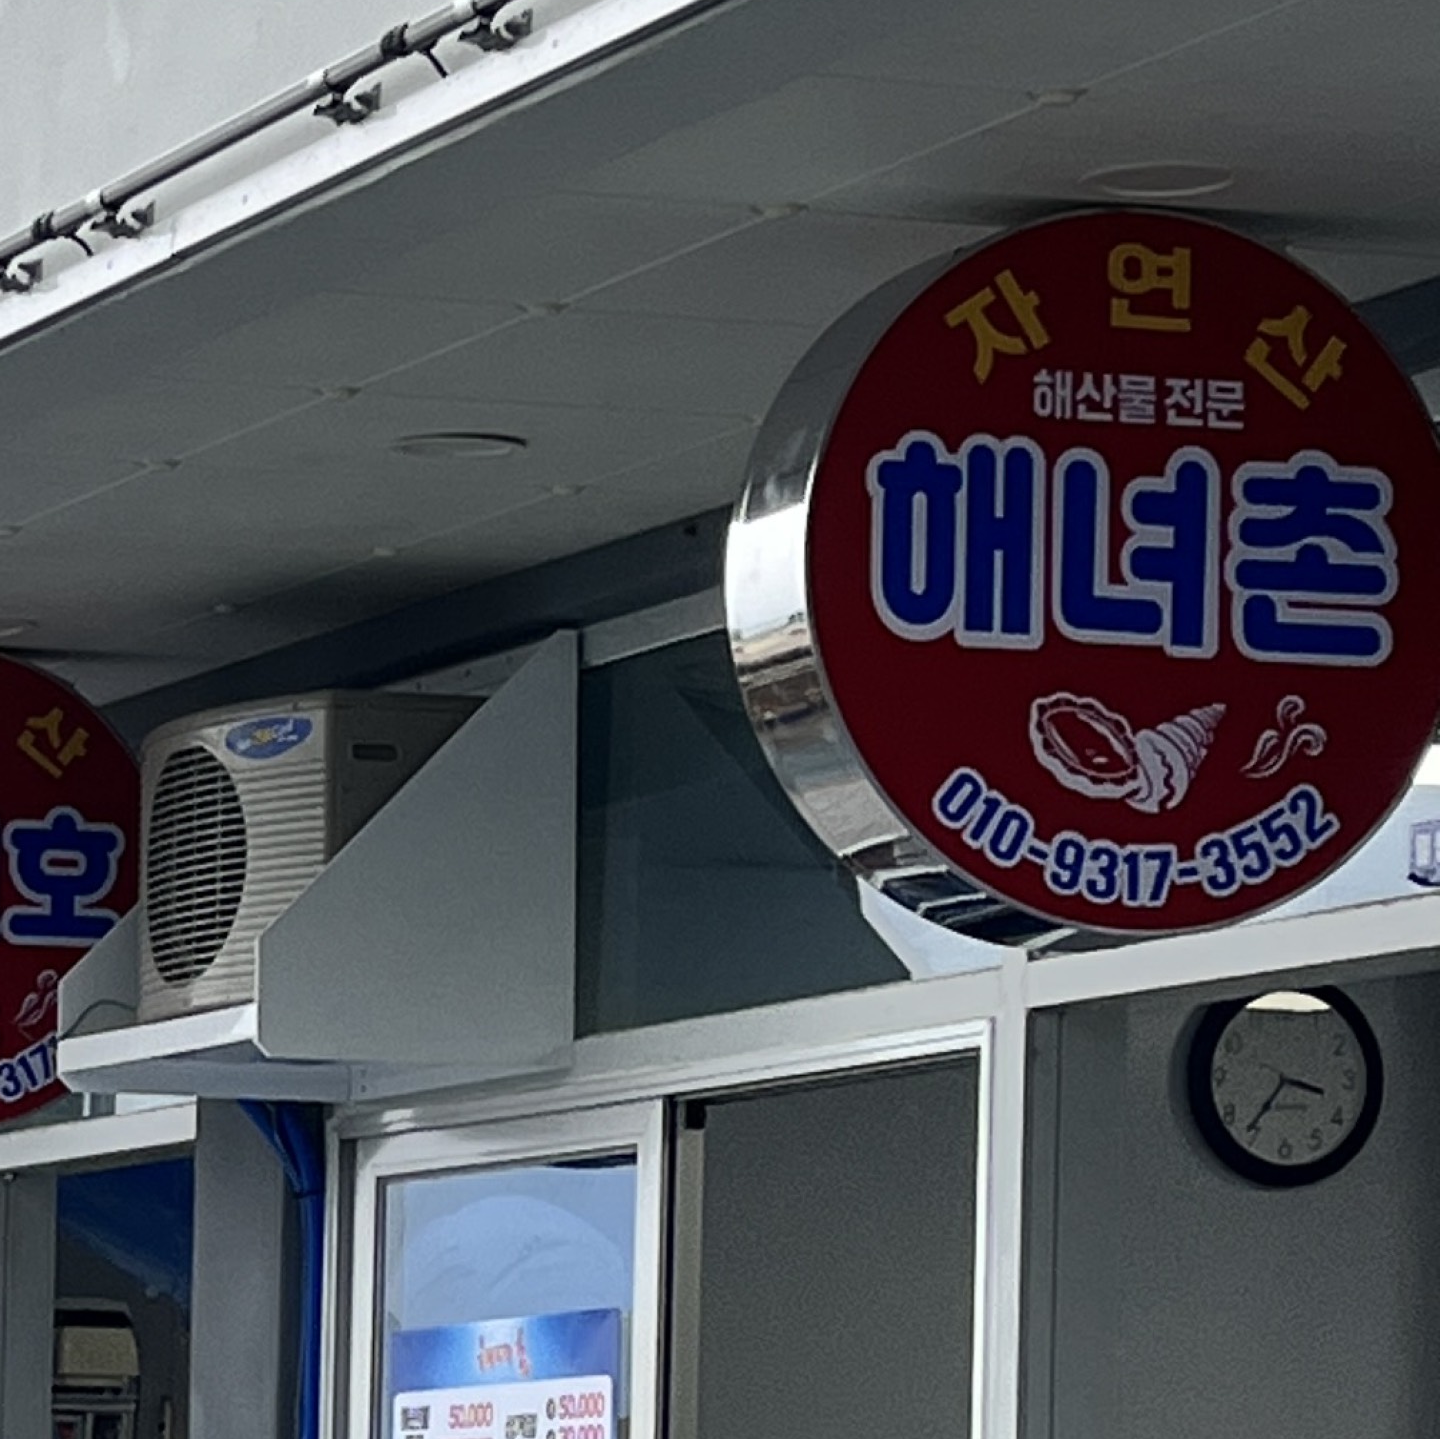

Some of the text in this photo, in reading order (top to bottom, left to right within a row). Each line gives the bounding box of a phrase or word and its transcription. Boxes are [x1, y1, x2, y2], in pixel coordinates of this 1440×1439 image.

[1032, 369, 1245, 431] 해산물 전문
[867, 431, 1396, 667] 해녀촌
[932, 766, 1340, 907] 010-9317-3552
